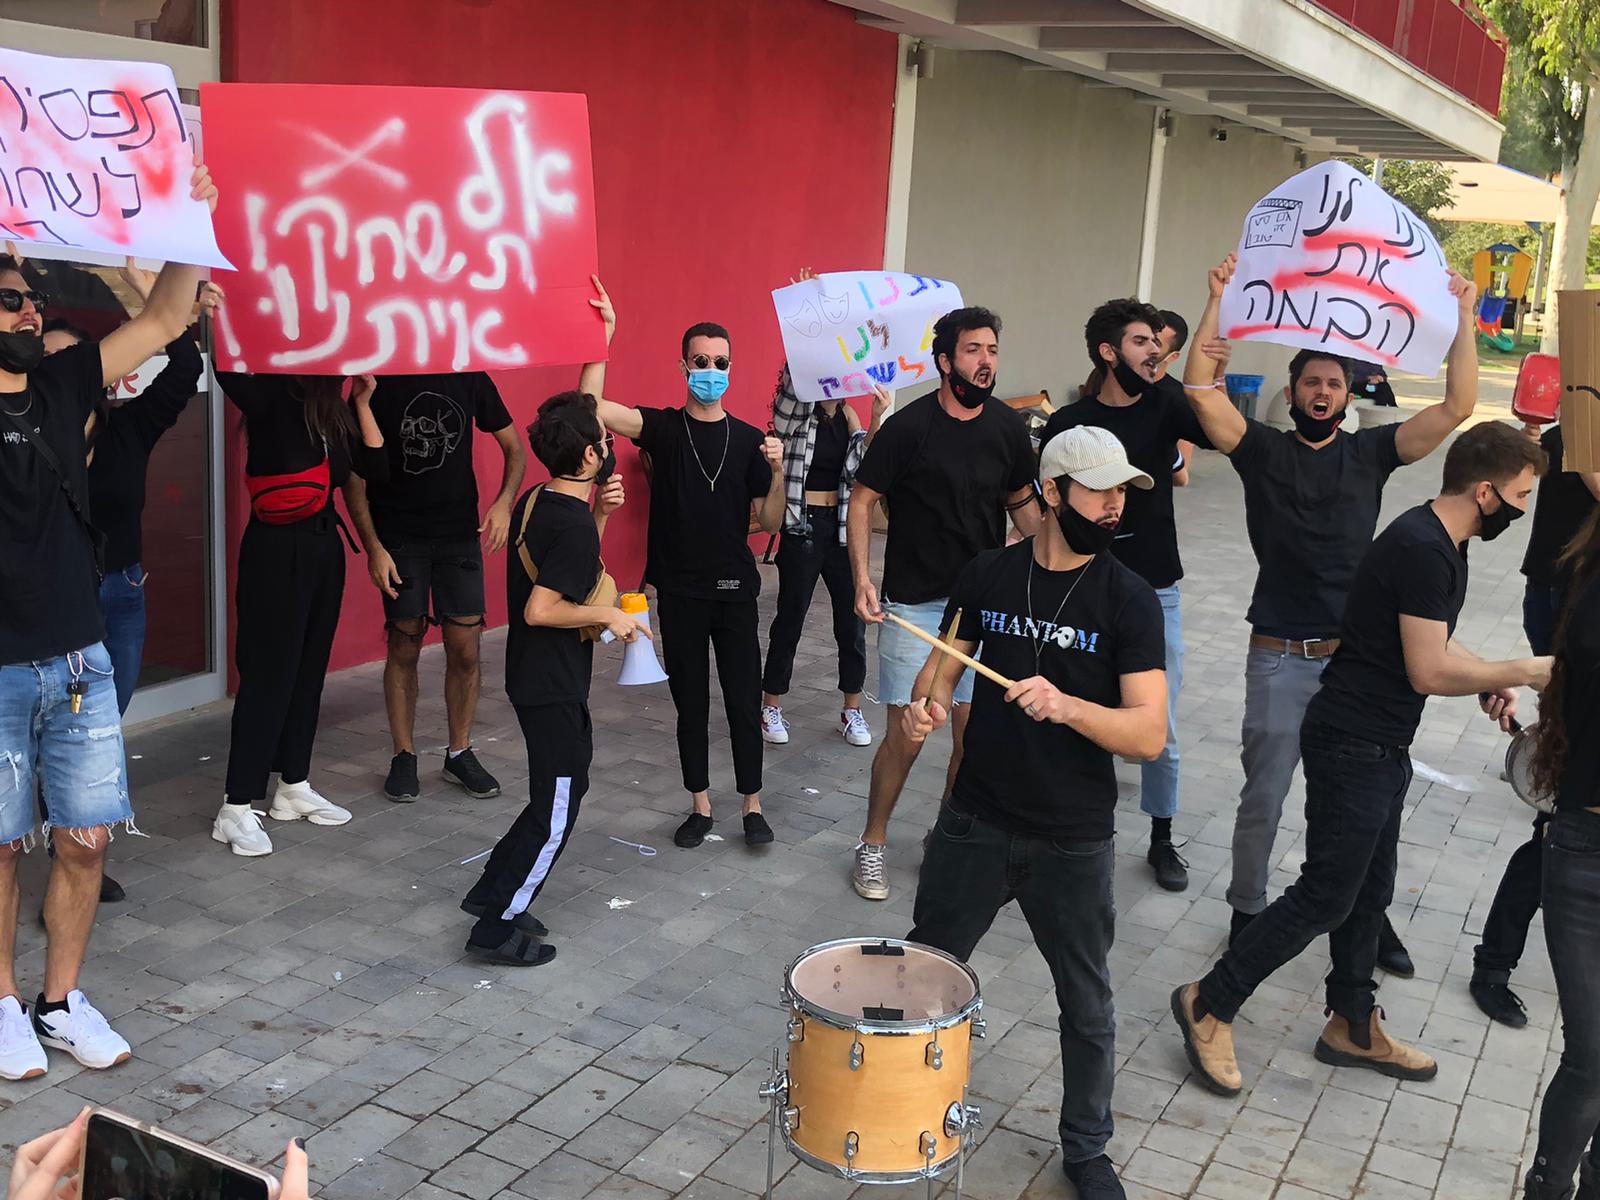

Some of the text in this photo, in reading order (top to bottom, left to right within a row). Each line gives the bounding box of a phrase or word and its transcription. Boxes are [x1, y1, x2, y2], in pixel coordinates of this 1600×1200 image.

[459, 93, 577, 239] אל
[1303, 174, 1443, 267] תנו לנו
[1304, 242, 1395, 295] את
[817, 355, 927, 398] לשחק
